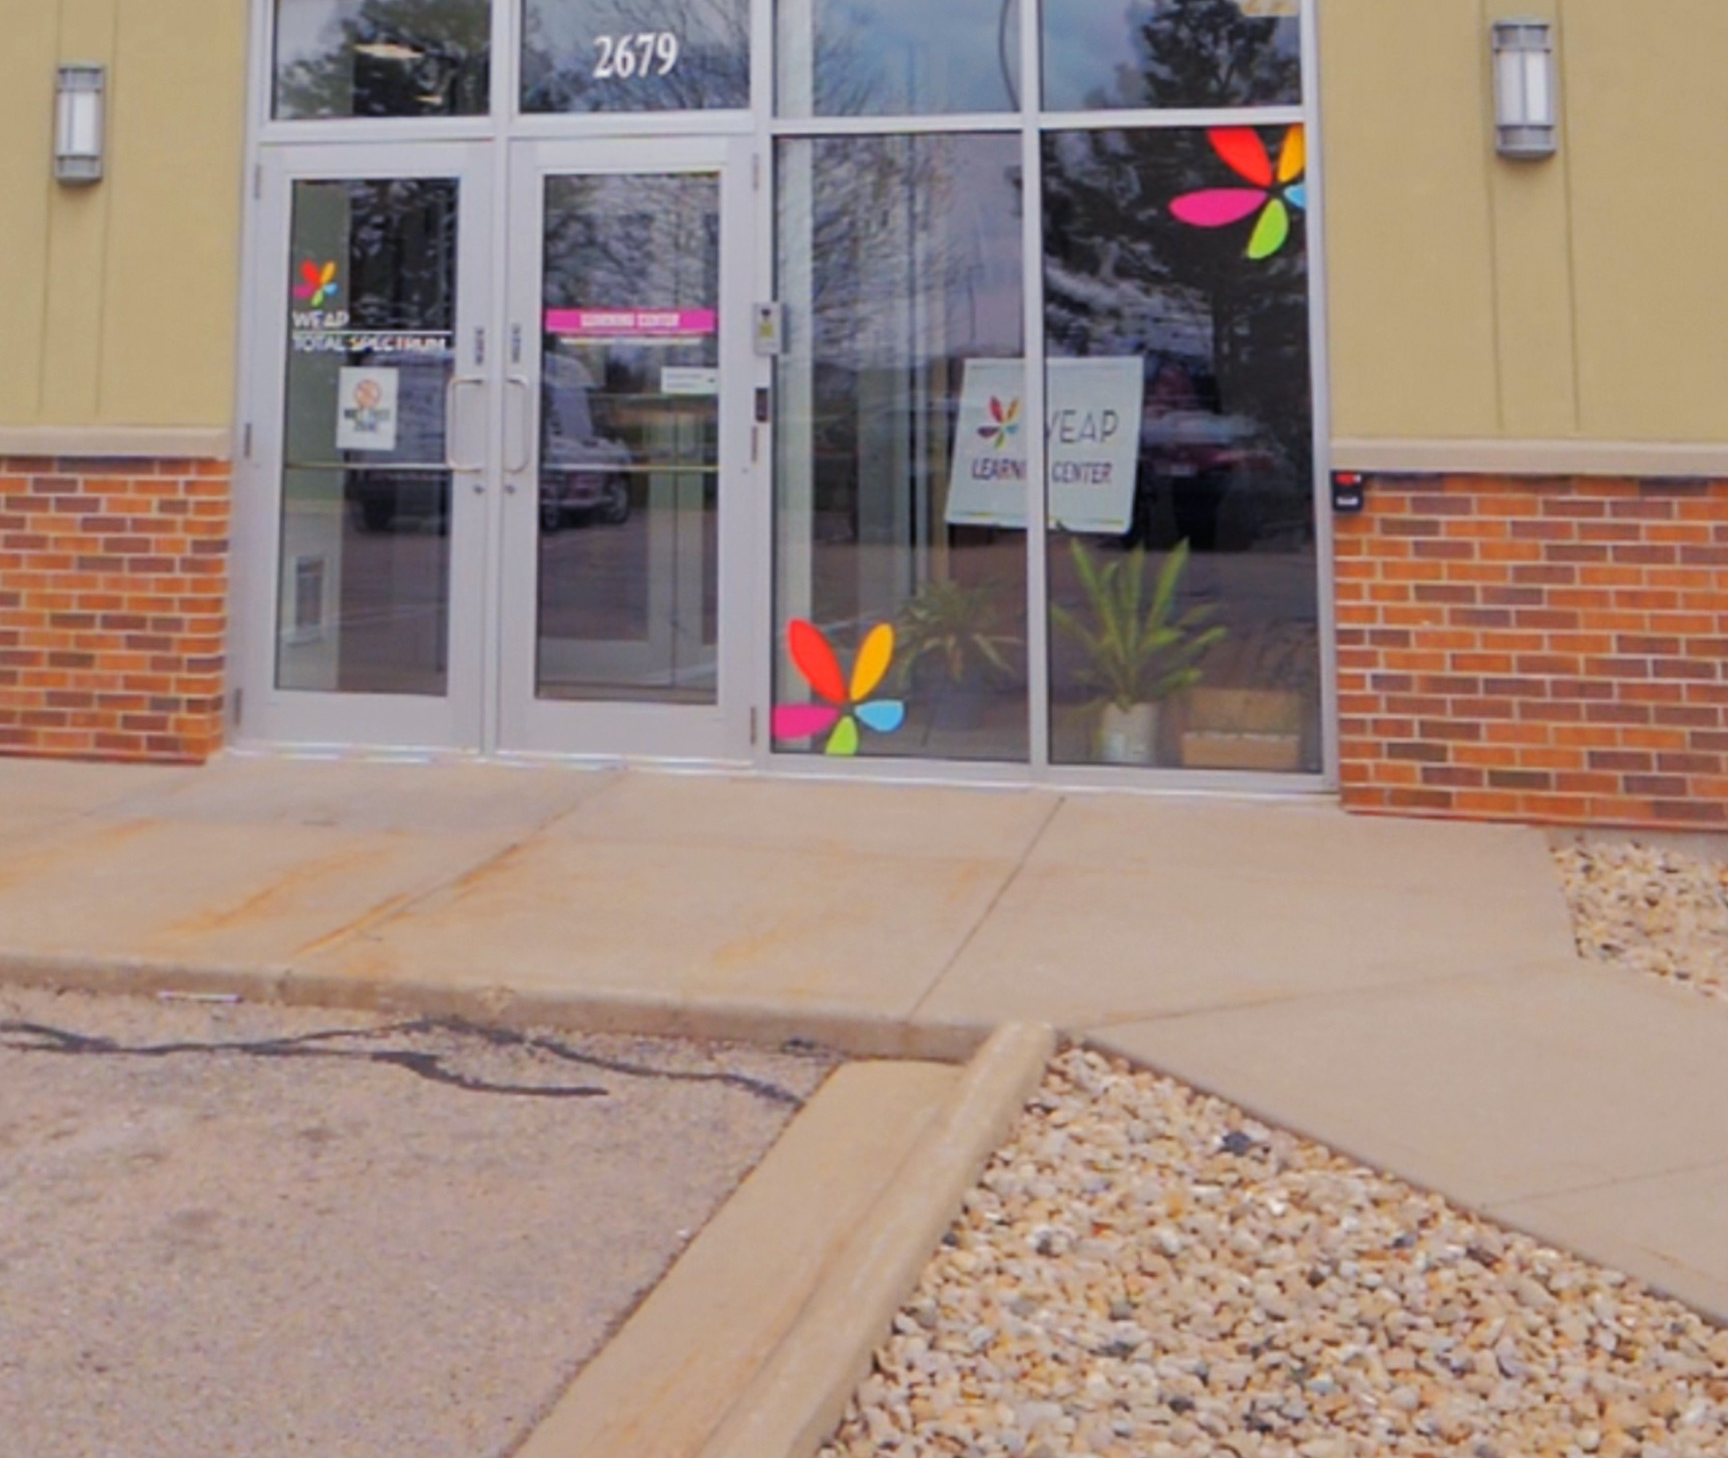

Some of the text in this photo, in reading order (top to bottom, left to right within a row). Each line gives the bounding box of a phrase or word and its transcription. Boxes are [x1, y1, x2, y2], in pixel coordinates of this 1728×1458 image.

[592, 31, 678, 78] 2679
[293, 334, 346, 352] TOTAL
[1048, 409, 1119, 443] EAP
[971, 457, 1113, 485] LEARN CENTER
